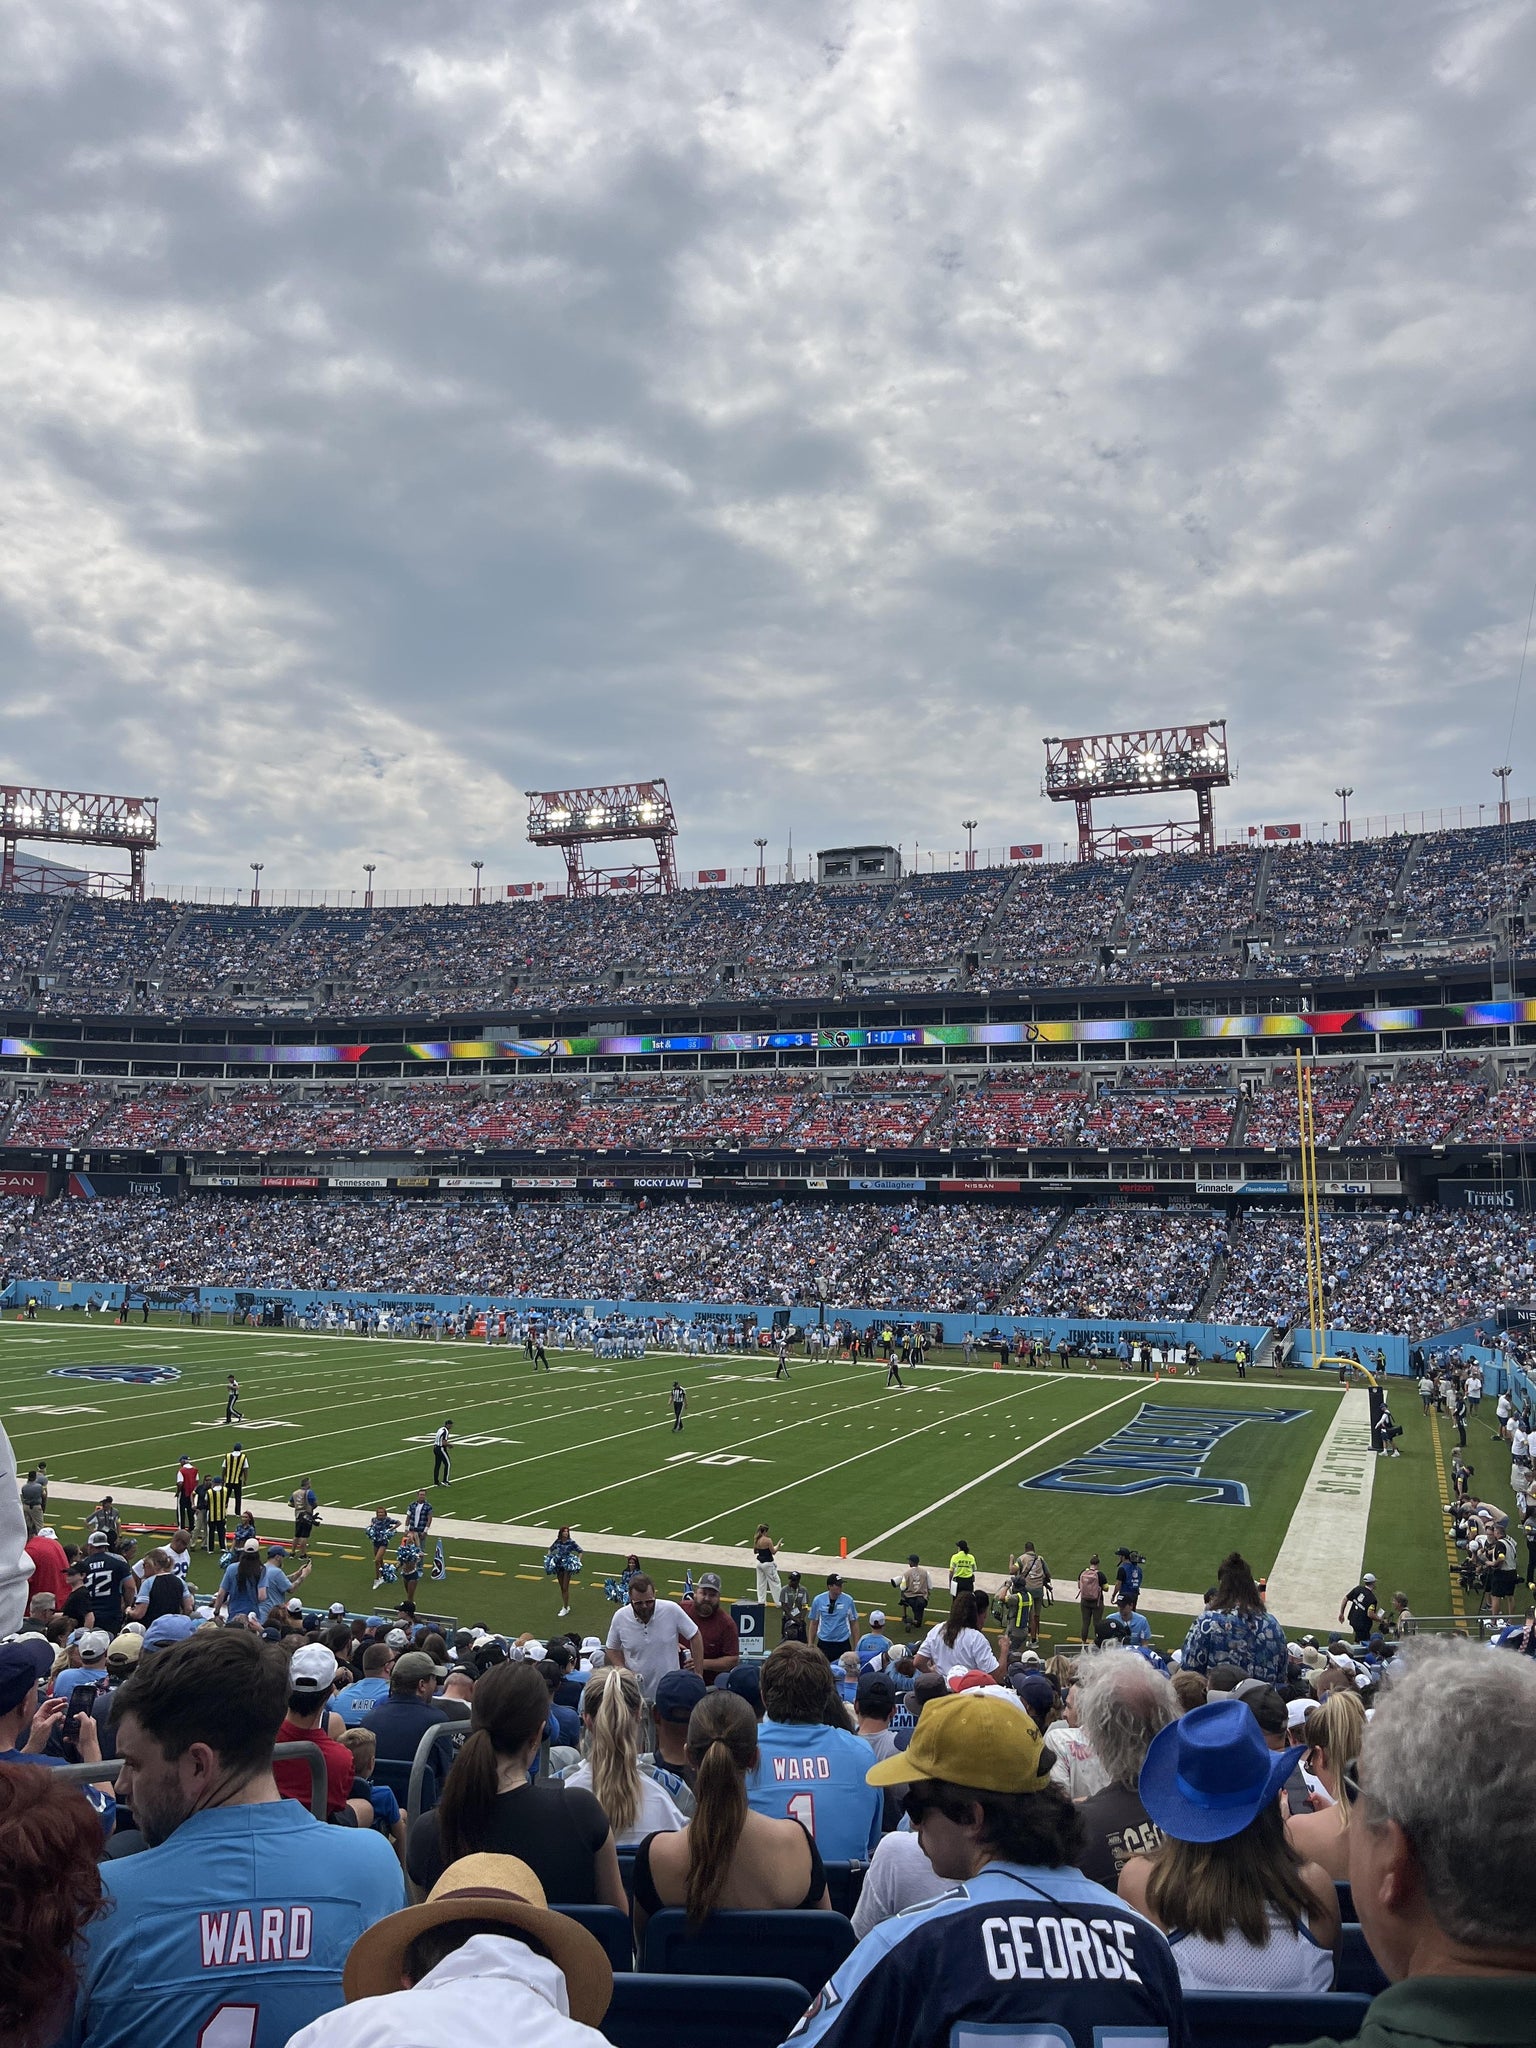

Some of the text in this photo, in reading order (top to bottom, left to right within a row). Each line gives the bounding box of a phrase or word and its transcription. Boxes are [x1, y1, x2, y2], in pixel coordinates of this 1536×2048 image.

[756, 1036, 770, 1047] 17
[795, 1034, 804, 1046] 3
[866, 1031, 895, 1044] 1:07
[651, 1040, 664, 1049] 1st
[128, 1181, 162, 1194] TITANS
[592, 1179, 615, 1188] FedEx
[633, 1179, 663, 1187] ROCKY
[665, 1179, 685, 1187] LAW
[874, 1180, 915, 1189] Gallagher
[1119, 1184, 1155, 1192] verizon
[1341, 1185, 1366, 1193] tsu
[1463, 1189, 1515, 1207] TITANS
[1068, 1330, 1115, 1344] TENNESSEE
[664, 1451, 754, 1465] 10
[1018, 1402, 1313, 1507] TITANS
[1321, 1465, 1365, 1478] OF
[1315, 1480, 1362, 1495] US
[740, 1614, 756, 1634] D
[773, 1755, 831, 1781] WARD
[786, 1792, 816, 1840] 1
[200, 1905, 313, 1968] WARD
[981, 1916, 1143, 1985] GEORGE
